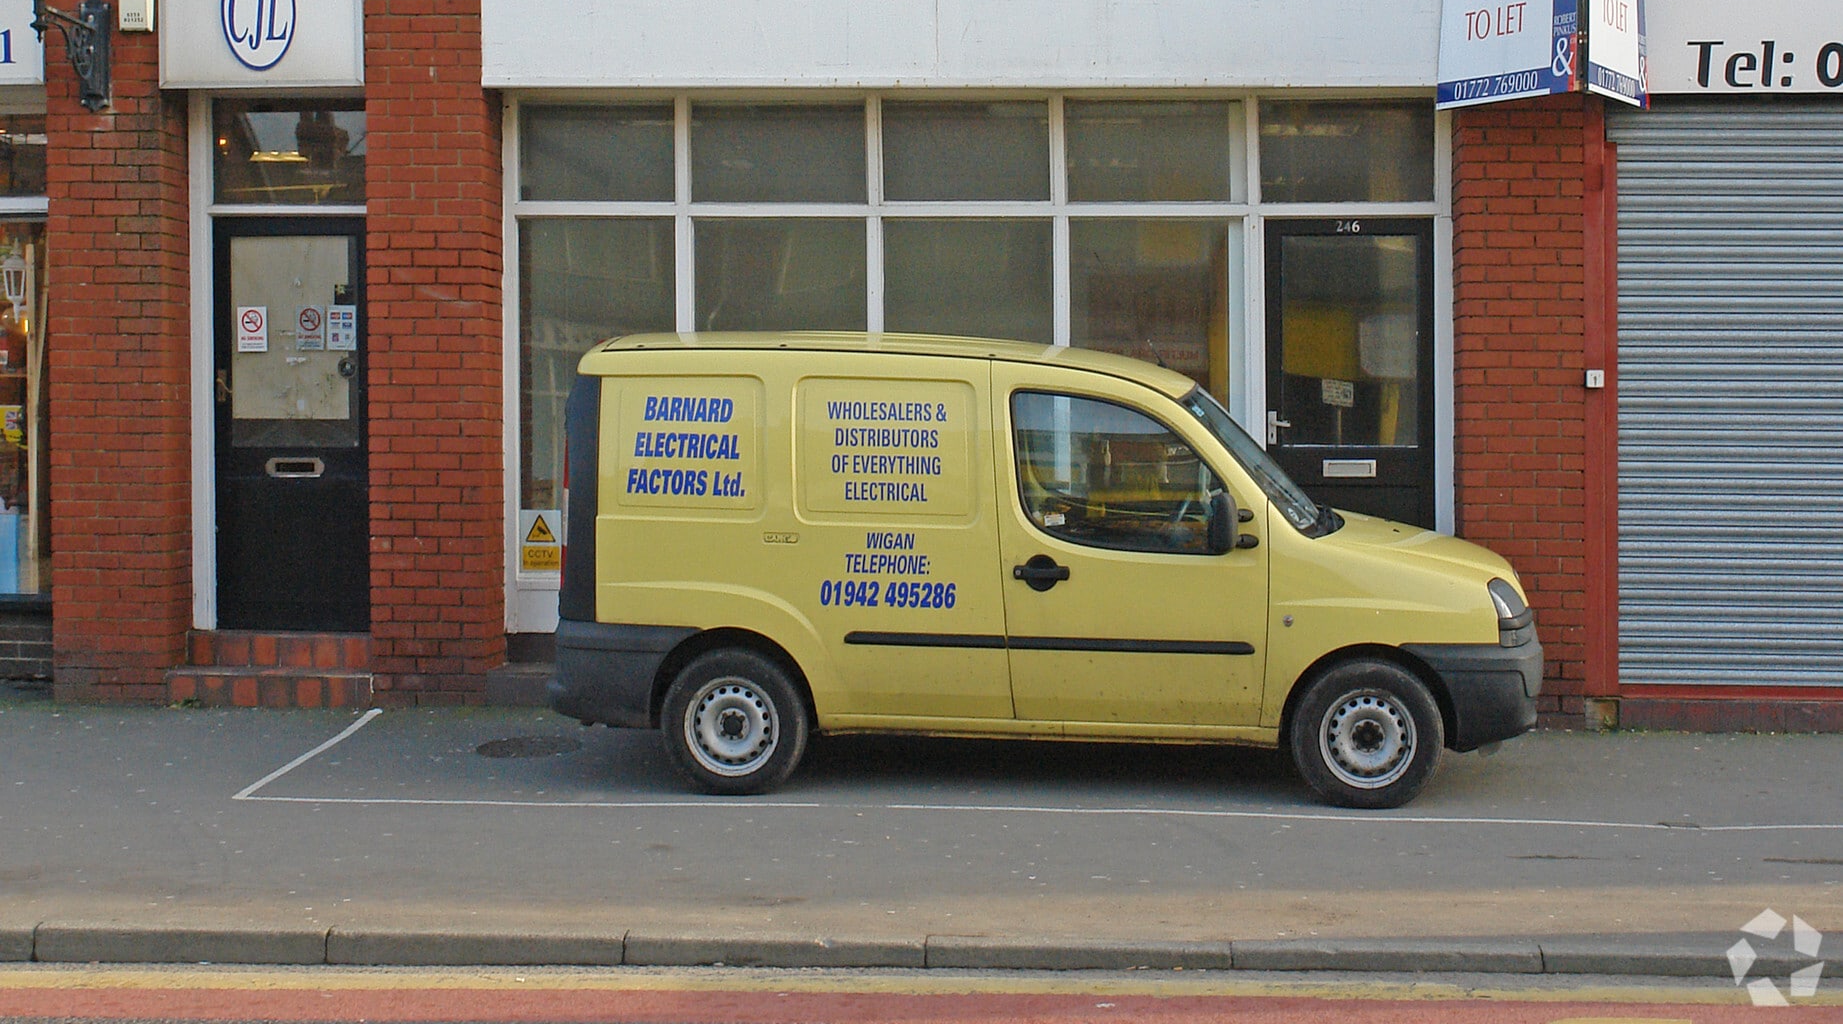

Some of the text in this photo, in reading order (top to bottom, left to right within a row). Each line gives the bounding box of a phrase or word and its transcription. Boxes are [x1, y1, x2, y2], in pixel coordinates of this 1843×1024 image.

[1465, 2, 1527, 41] TO LET
[1553, 11, 1577, 25] ROBERT
[1615, 0, 1628, 34] LET
[1553, 24, 1577, 37] PINKUS
[1552, 37, 1574, 77] &
[1687, 40, 1794, 88] Tel:
[1454, 71, 1538, 101] 01772 769000
[1336, 220, 1360, 233] 246
[644, 396, 734, 423] BARNARD
[827, 401, 947, 422] WHOLESALERS &
[634, 432, 740, 460] ELECTRICAL
[835, 428, 939, 448] DISTRIBUTORS
[831, 454, 941, 475] OF EVERYTHING
[627, 468, 745, 497] FACTORS Ltd.
[845, 481, 928, 502] ELECTRICAL
[866, 532, 915, 550] WIGAN
[528, 549, 553, 558] CCTV
[845, 554, 931, 575] TELEPHONE:
[820, 580, 957, 609] 01942 495286
